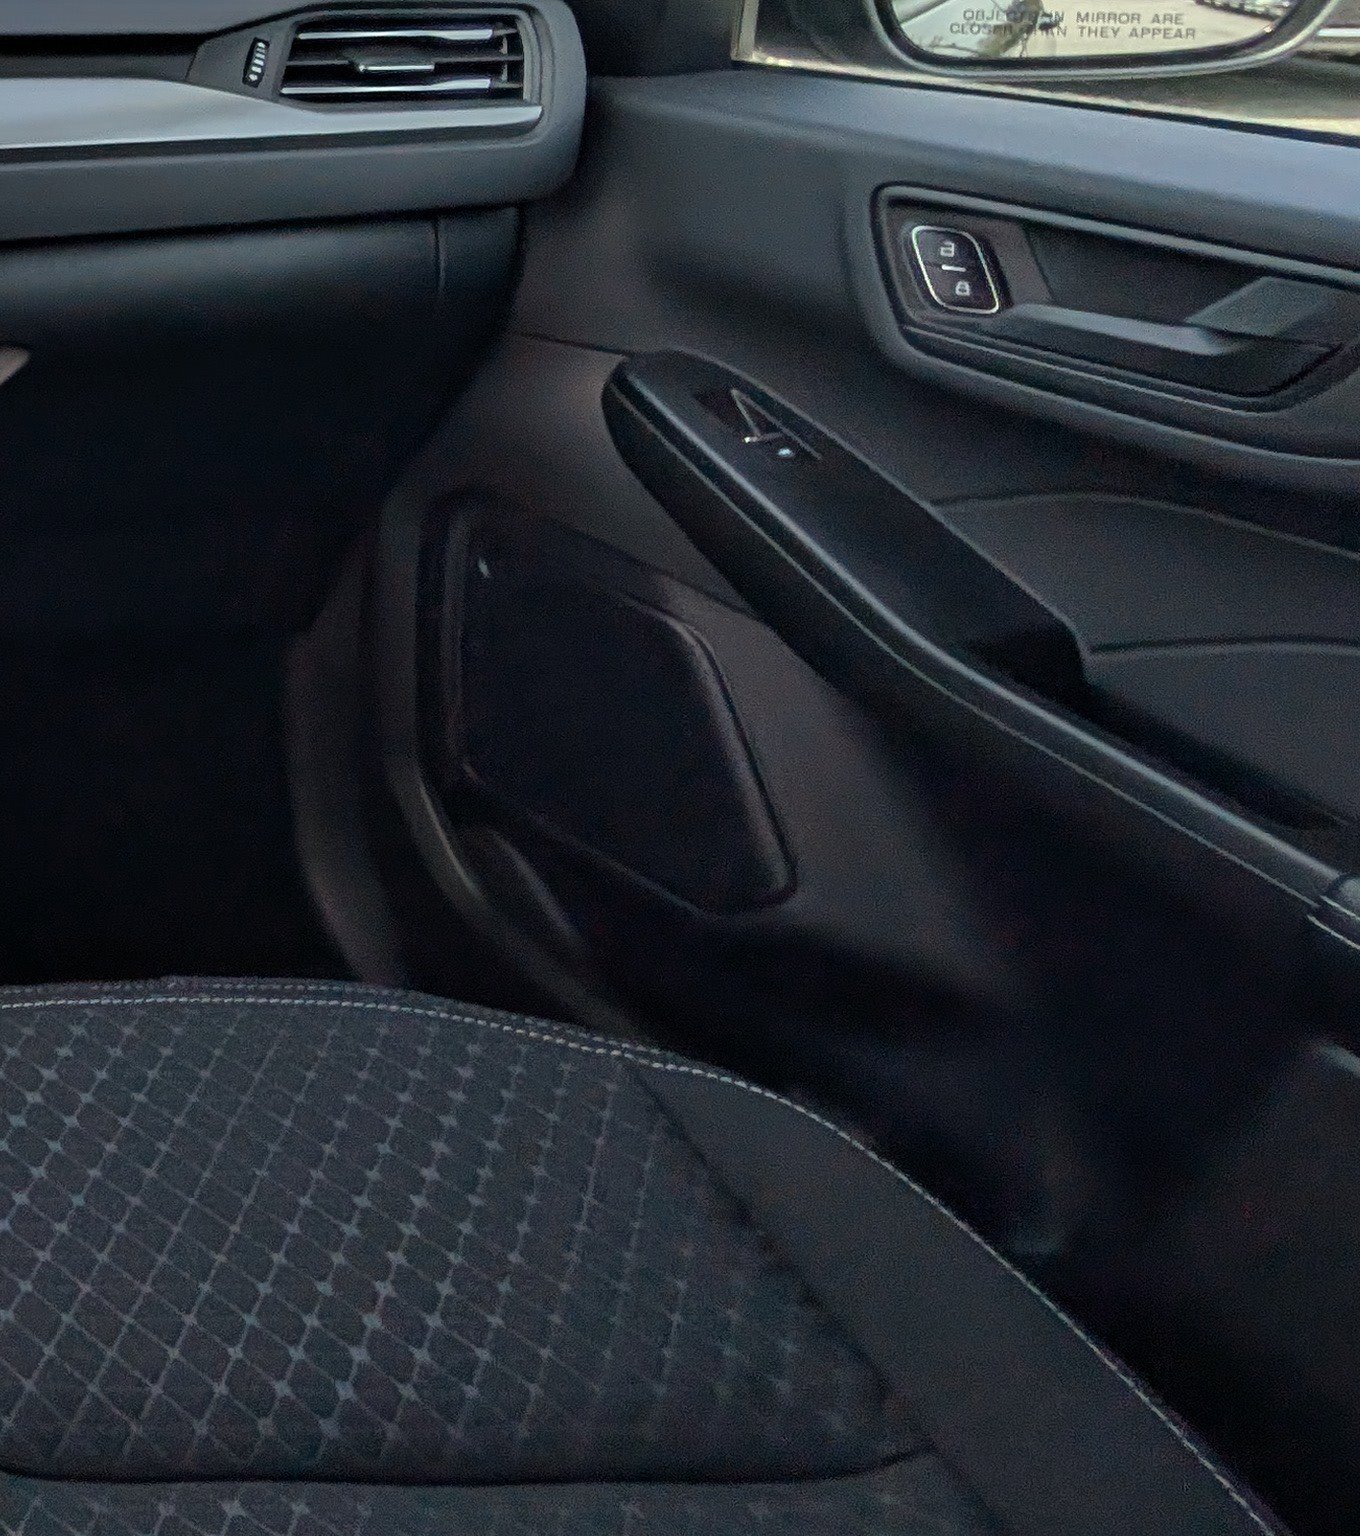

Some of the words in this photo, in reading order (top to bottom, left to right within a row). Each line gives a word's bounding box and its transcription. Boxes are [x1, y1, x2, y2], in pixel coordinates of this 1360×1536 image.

[1076, 11, 1141, 24] MIRROR
[1151, 12, 1185, 25] ARE
[1079, 26, 1121, 39] THEY
[1130, 27, 1197, 40] APPEAR
